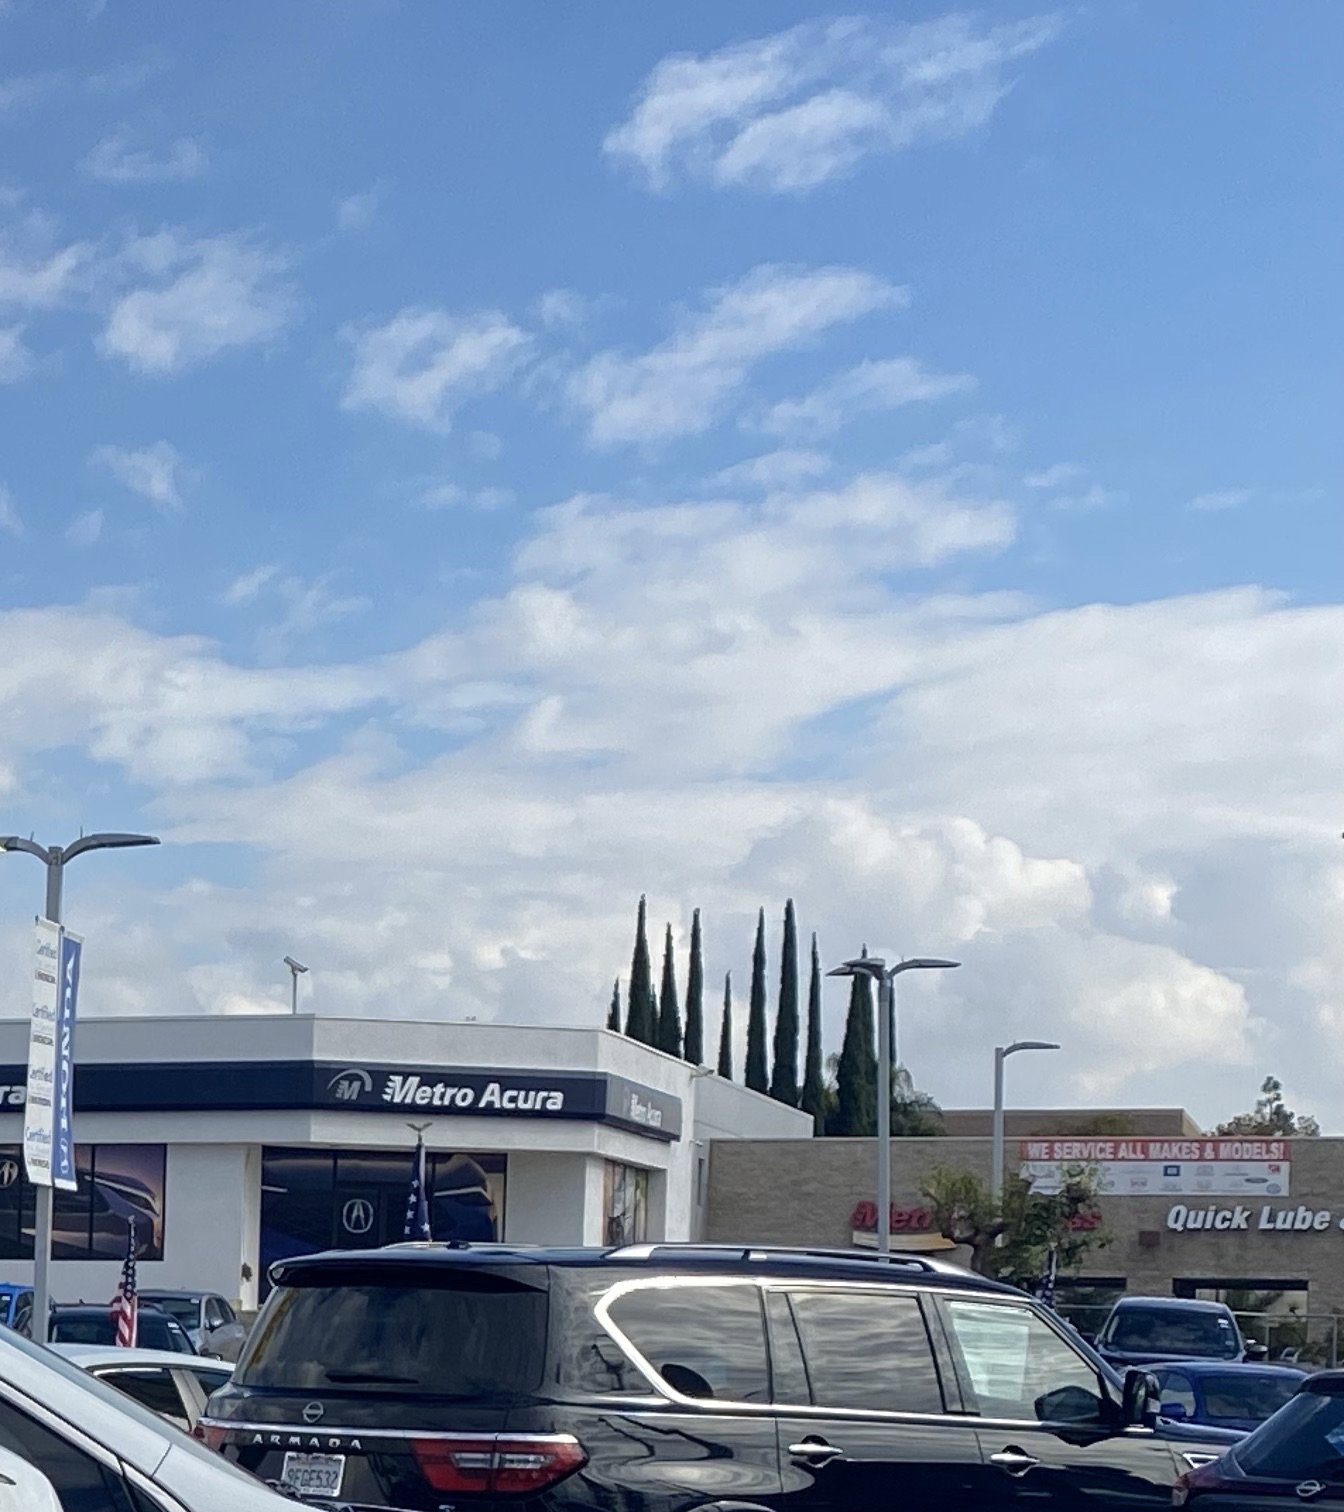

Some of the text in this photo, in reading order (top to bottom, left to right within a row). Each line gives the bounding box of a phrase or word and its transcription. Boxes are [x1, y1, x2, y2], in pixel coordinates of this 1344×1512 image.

[381, 1074, 565, 1111] Metro Acura
[1028, 1141, 1285, 1160] WE SERVICE ALL MAKES & MODELS!
[1167, 1204, 1252, 1231] Quick
[1258, 1205, 1331, 1231] Lube
[252, 1433, 363, 1450] ARMADA
